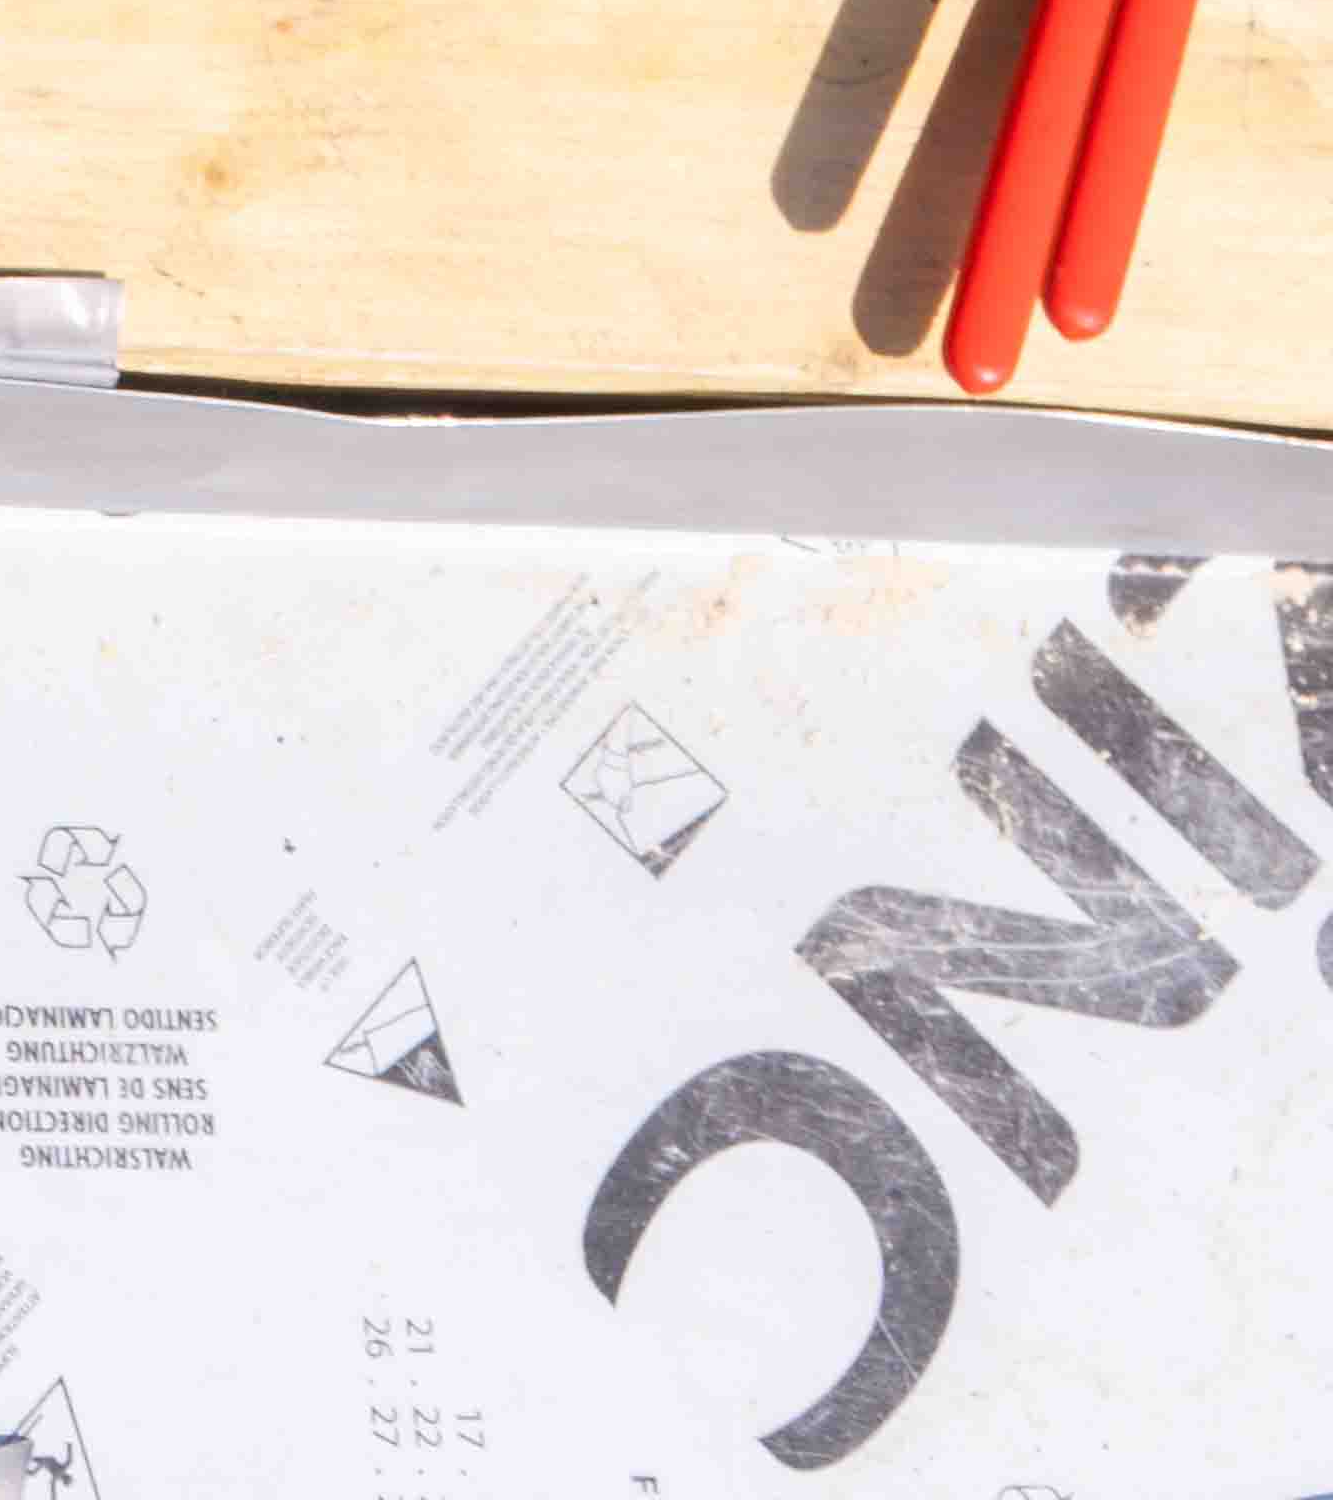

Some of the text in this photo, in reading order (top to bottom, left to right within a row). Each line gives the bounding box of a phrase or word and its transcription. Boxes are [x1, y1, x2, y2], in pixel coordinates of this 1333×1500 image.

[122, 1007, 220, 1032] SENTIDO
[4, 1039, 190, 1066] WALZRICHTUNG
[118, 1076, 145, 1099] DE
[153, 1076, 209, 1100] SENS
[117, 1111, 216, 1136] ROLLING
[18, 1143, 193, 1170] WALSRICHTING
[363, 1315, 401, 1448] 26 27
[405, 1316, 444, 1448] 21 22
[454, 1409, 487, 1448] 17
